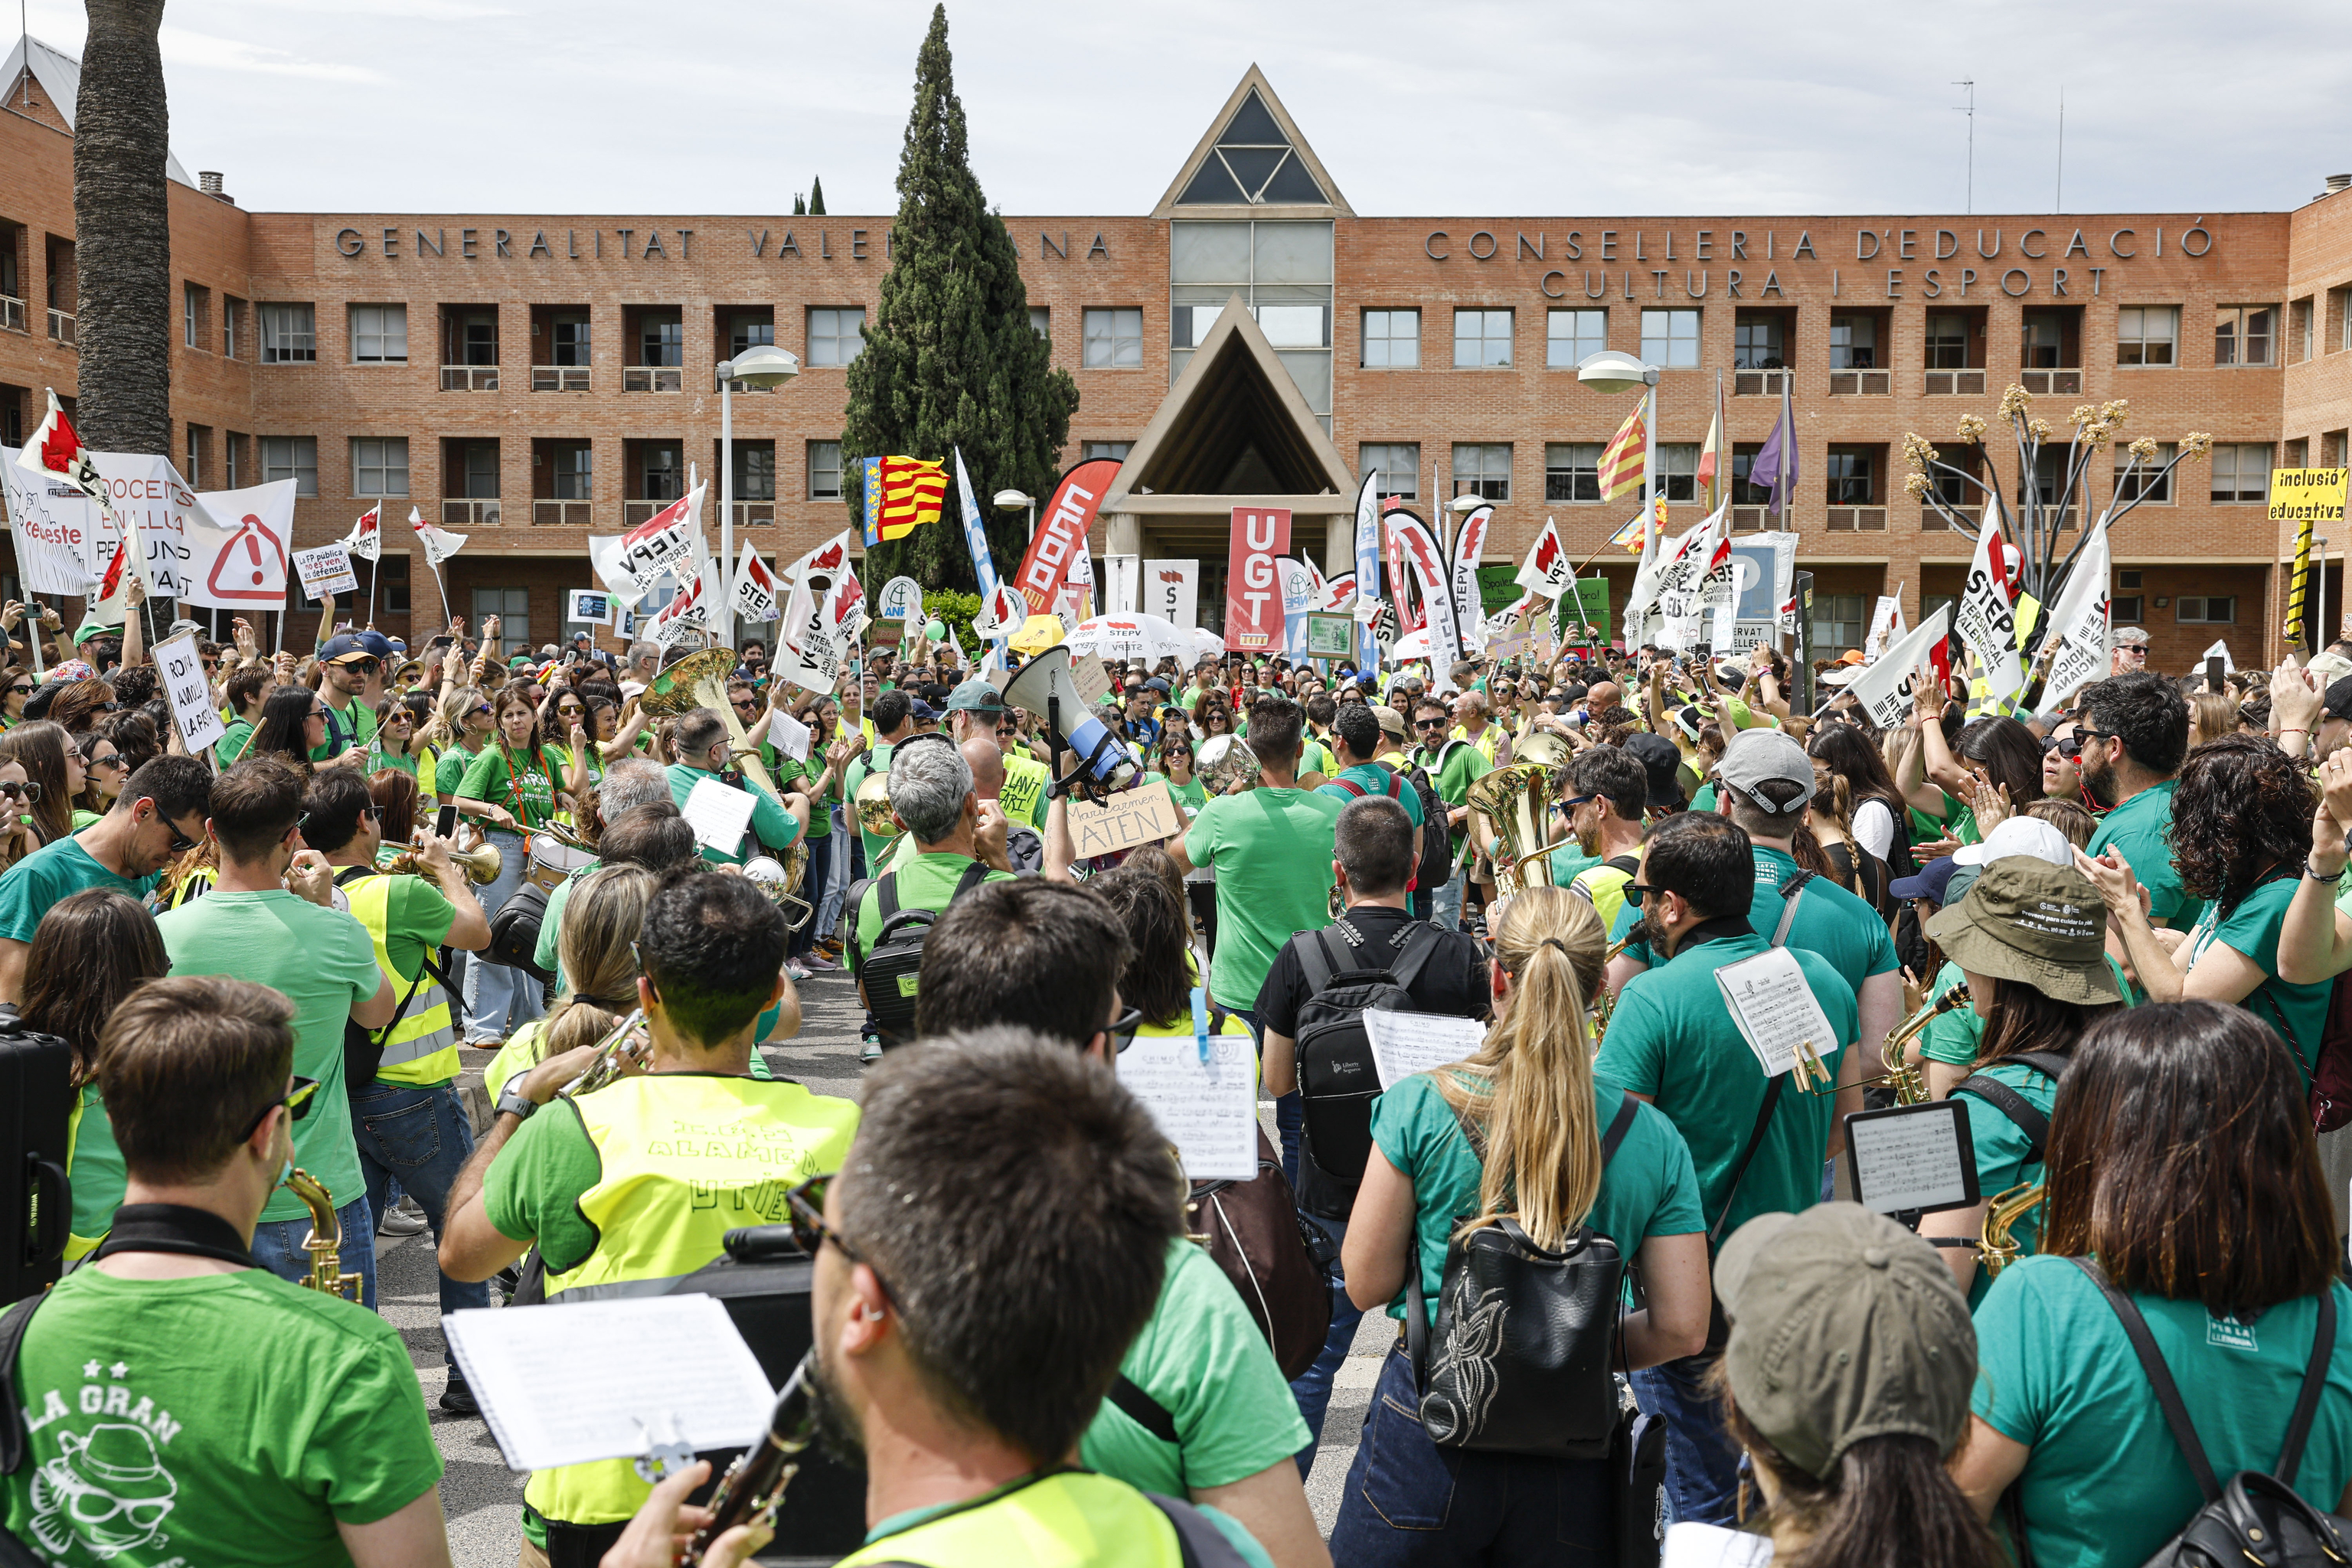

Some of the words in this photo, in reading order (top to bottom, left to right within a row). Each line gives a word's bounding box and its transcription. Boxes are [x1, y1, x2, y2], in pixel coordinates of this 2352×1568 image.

[335, 227, 693, 258] GENERALITAT
[747, 229, 1109, 259] VALENA
[1425, 230, 1817, 260] CONSELLERIA
[1857, 216, 2212, 260] D'EDUCACIÓ
[1540, 269, 1784, 299] CULTURA
[1887, 266, 2106, 298] ESPORT
[2280, 469, 2339, 487] inclusió
[2270, 501, 2344, 519] educativa
[1026, 483, 1093, 593] CCOO
[306, 554, 315, 564] FP
[316, 550, 343, 562] pública
[304, 571, 312, 580] es
[312, 563, 347, 578] defensa!
[1243, 514, 1276, 626] UGT
[1457, 565, 1468, 614] STEPV
[1580, 589, 1600, 600] bro!
[1966, 570, 2018, 653] STEPV
[1073, 630, 1096, 639] STEPV
[1733, 628, 1762, 636] ERVAT
[183, 717, 199, 738] LA
[1081, 806, 1162, 853] ATÉN
[2021, 910, 2046, 920] Prevenir
[2211, 1333, 2253, 1348] LLENGUA
[2234, 1327, 2250, 1338] LA
[21, 1388, 70, 1434] LA
[79, 1384, 183, 1446] GRAN
